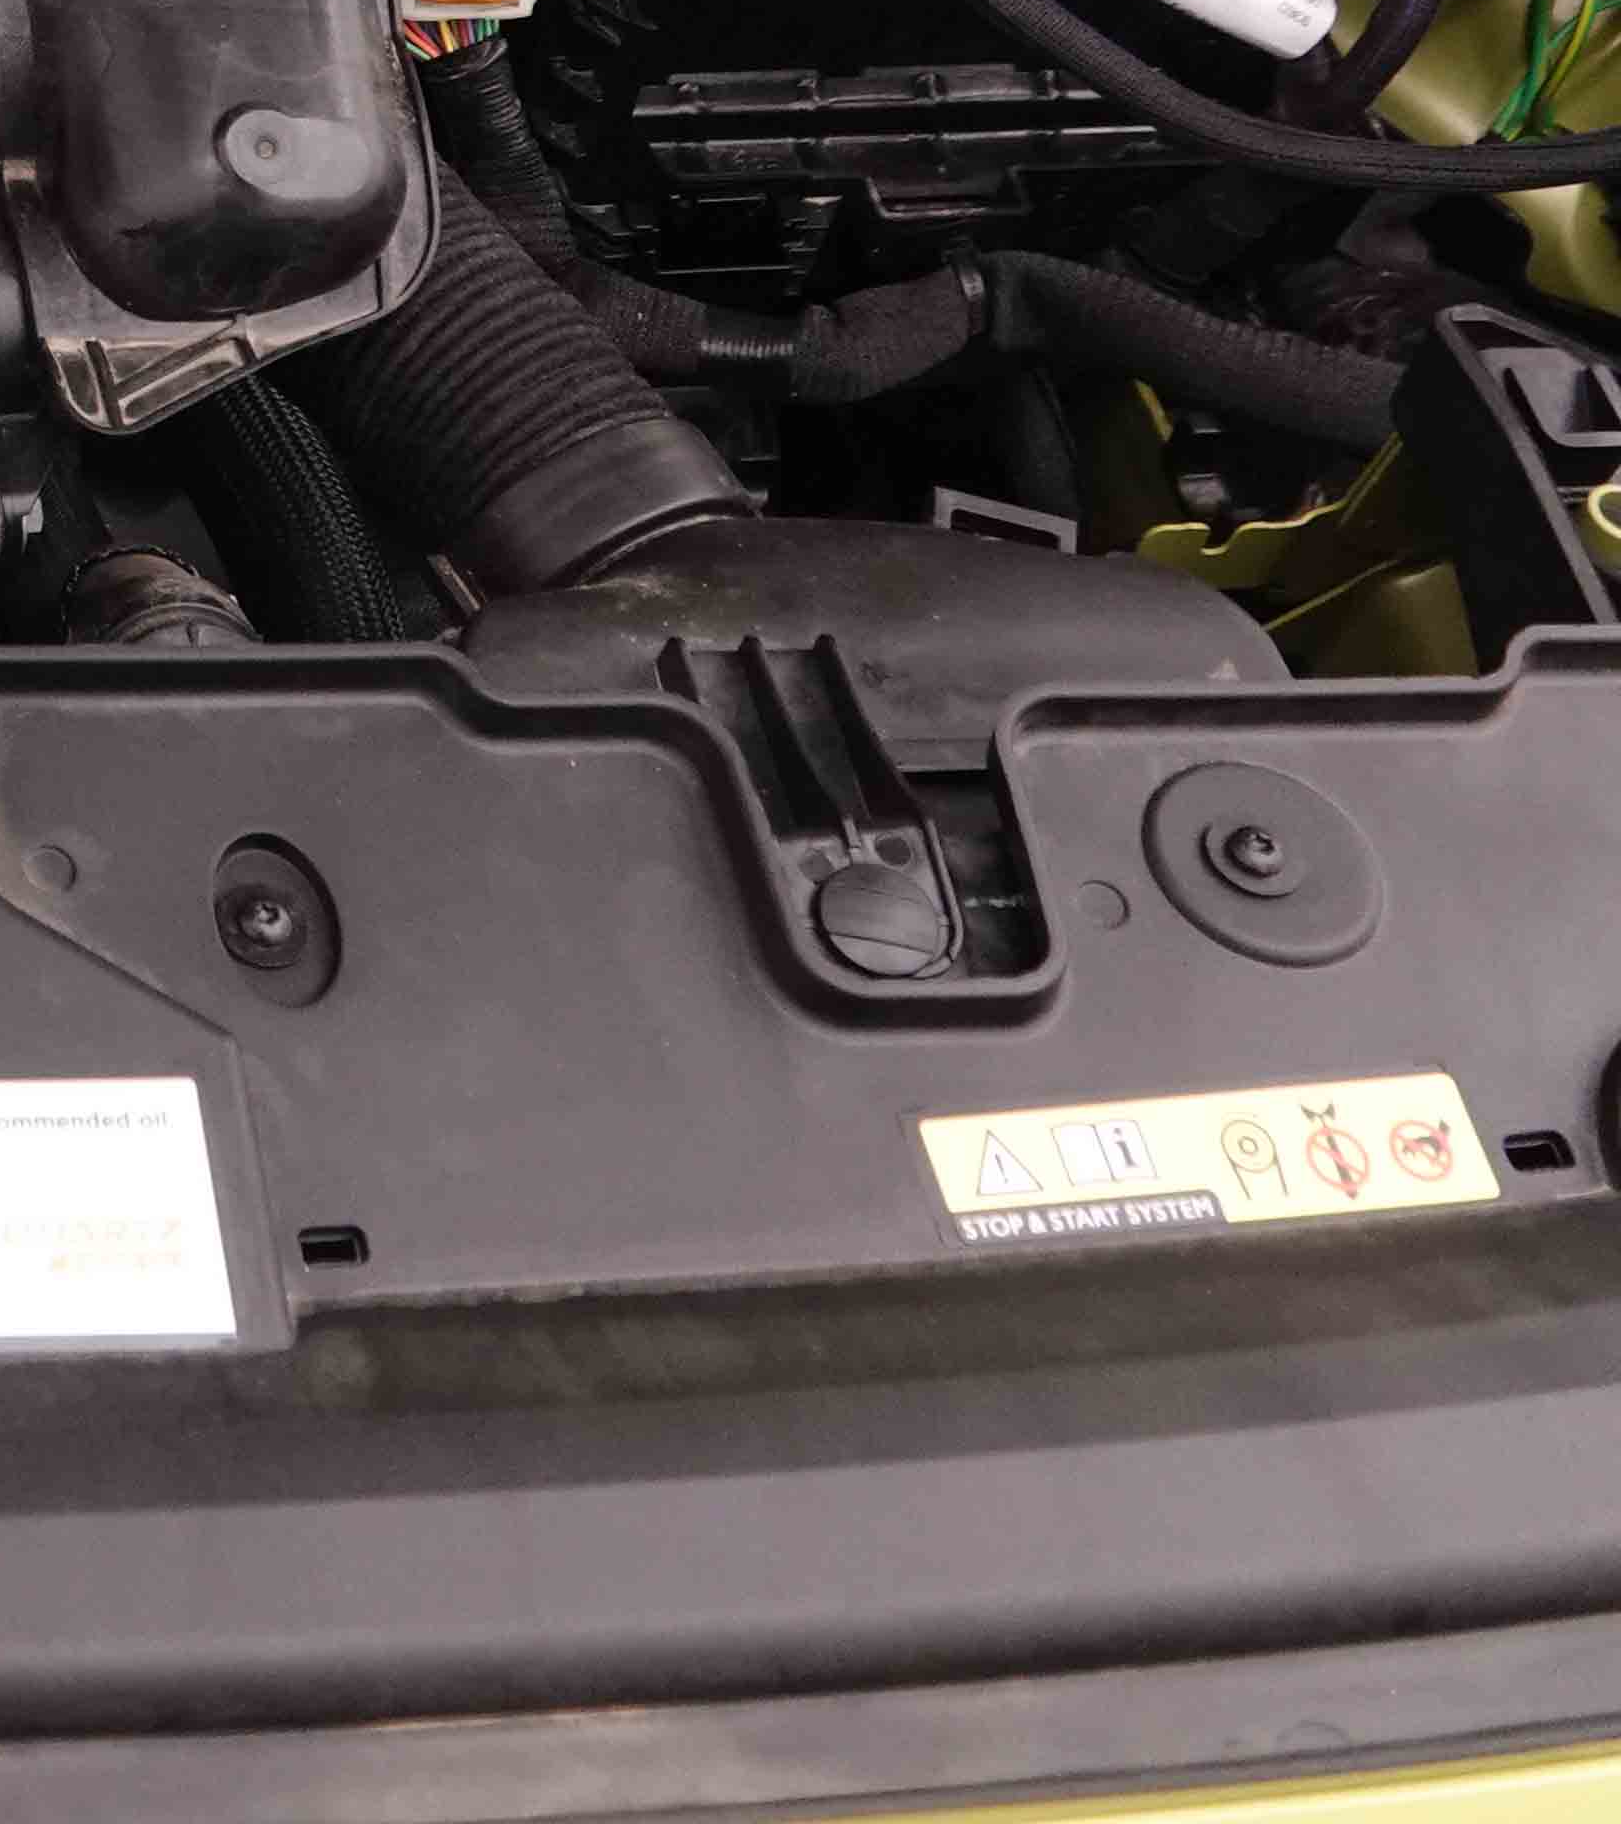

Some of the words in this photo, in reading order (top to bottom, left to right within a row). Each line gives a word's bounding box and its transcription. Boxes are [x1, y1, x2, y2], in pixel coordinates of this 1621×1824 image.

[962, 1212, 1024, 1241] STOP
[1027, 1210, 1047, 1234] &
[1049, 1205, 1120, 1233] START
[1124, 1194, 1216, 1226] SYSTEM
